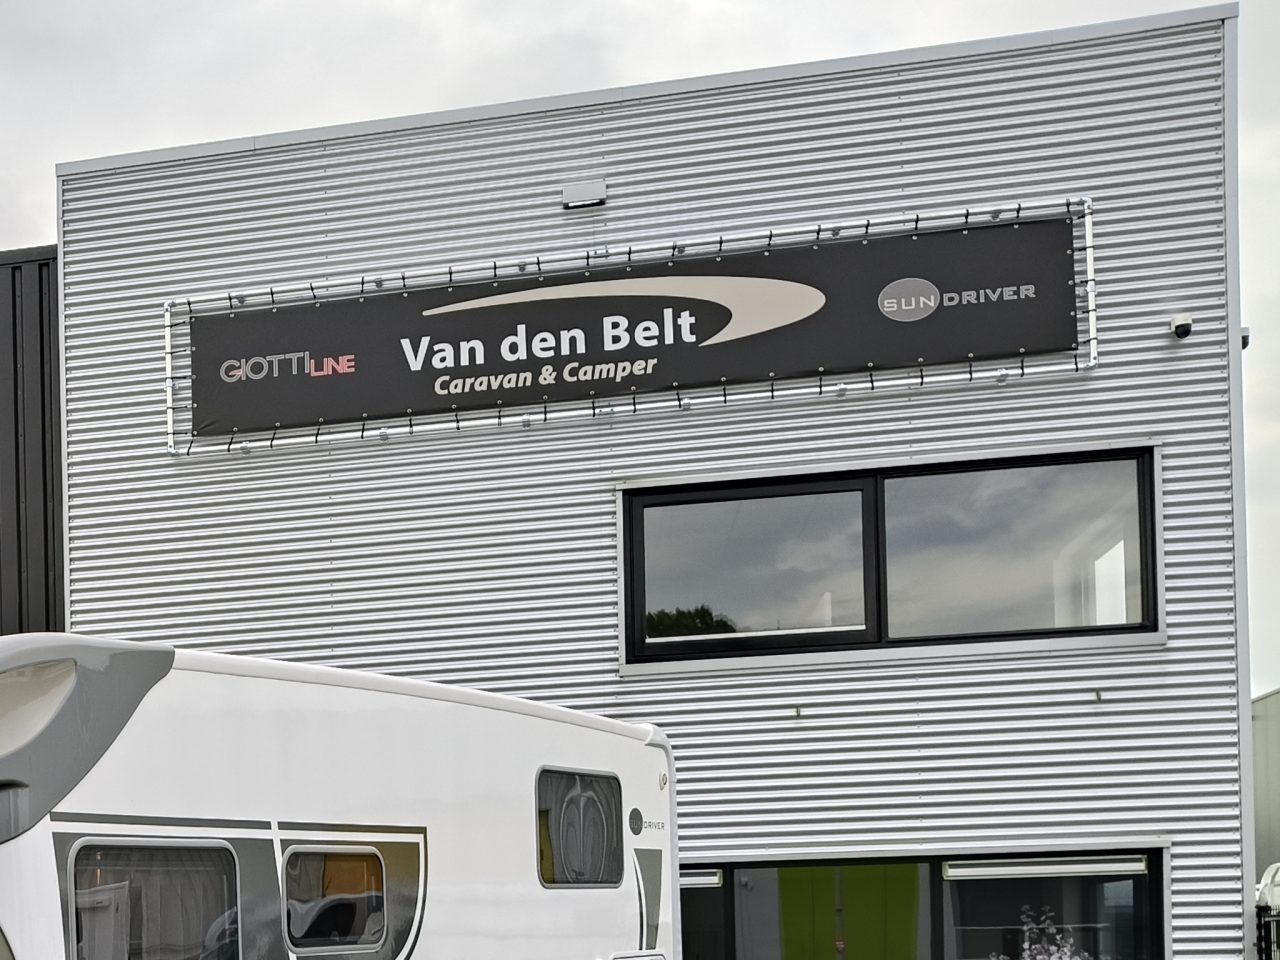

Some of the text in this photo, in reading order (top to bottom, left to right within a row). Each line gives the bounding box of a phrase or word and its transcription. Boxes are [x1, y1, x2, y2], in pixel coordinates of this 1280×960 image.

[883, 284, 1037, 312] SUN DRIVER
[400, 308, 697, 371] Van den Belt
[434, 357, 658, 395] Caravan & Camper
